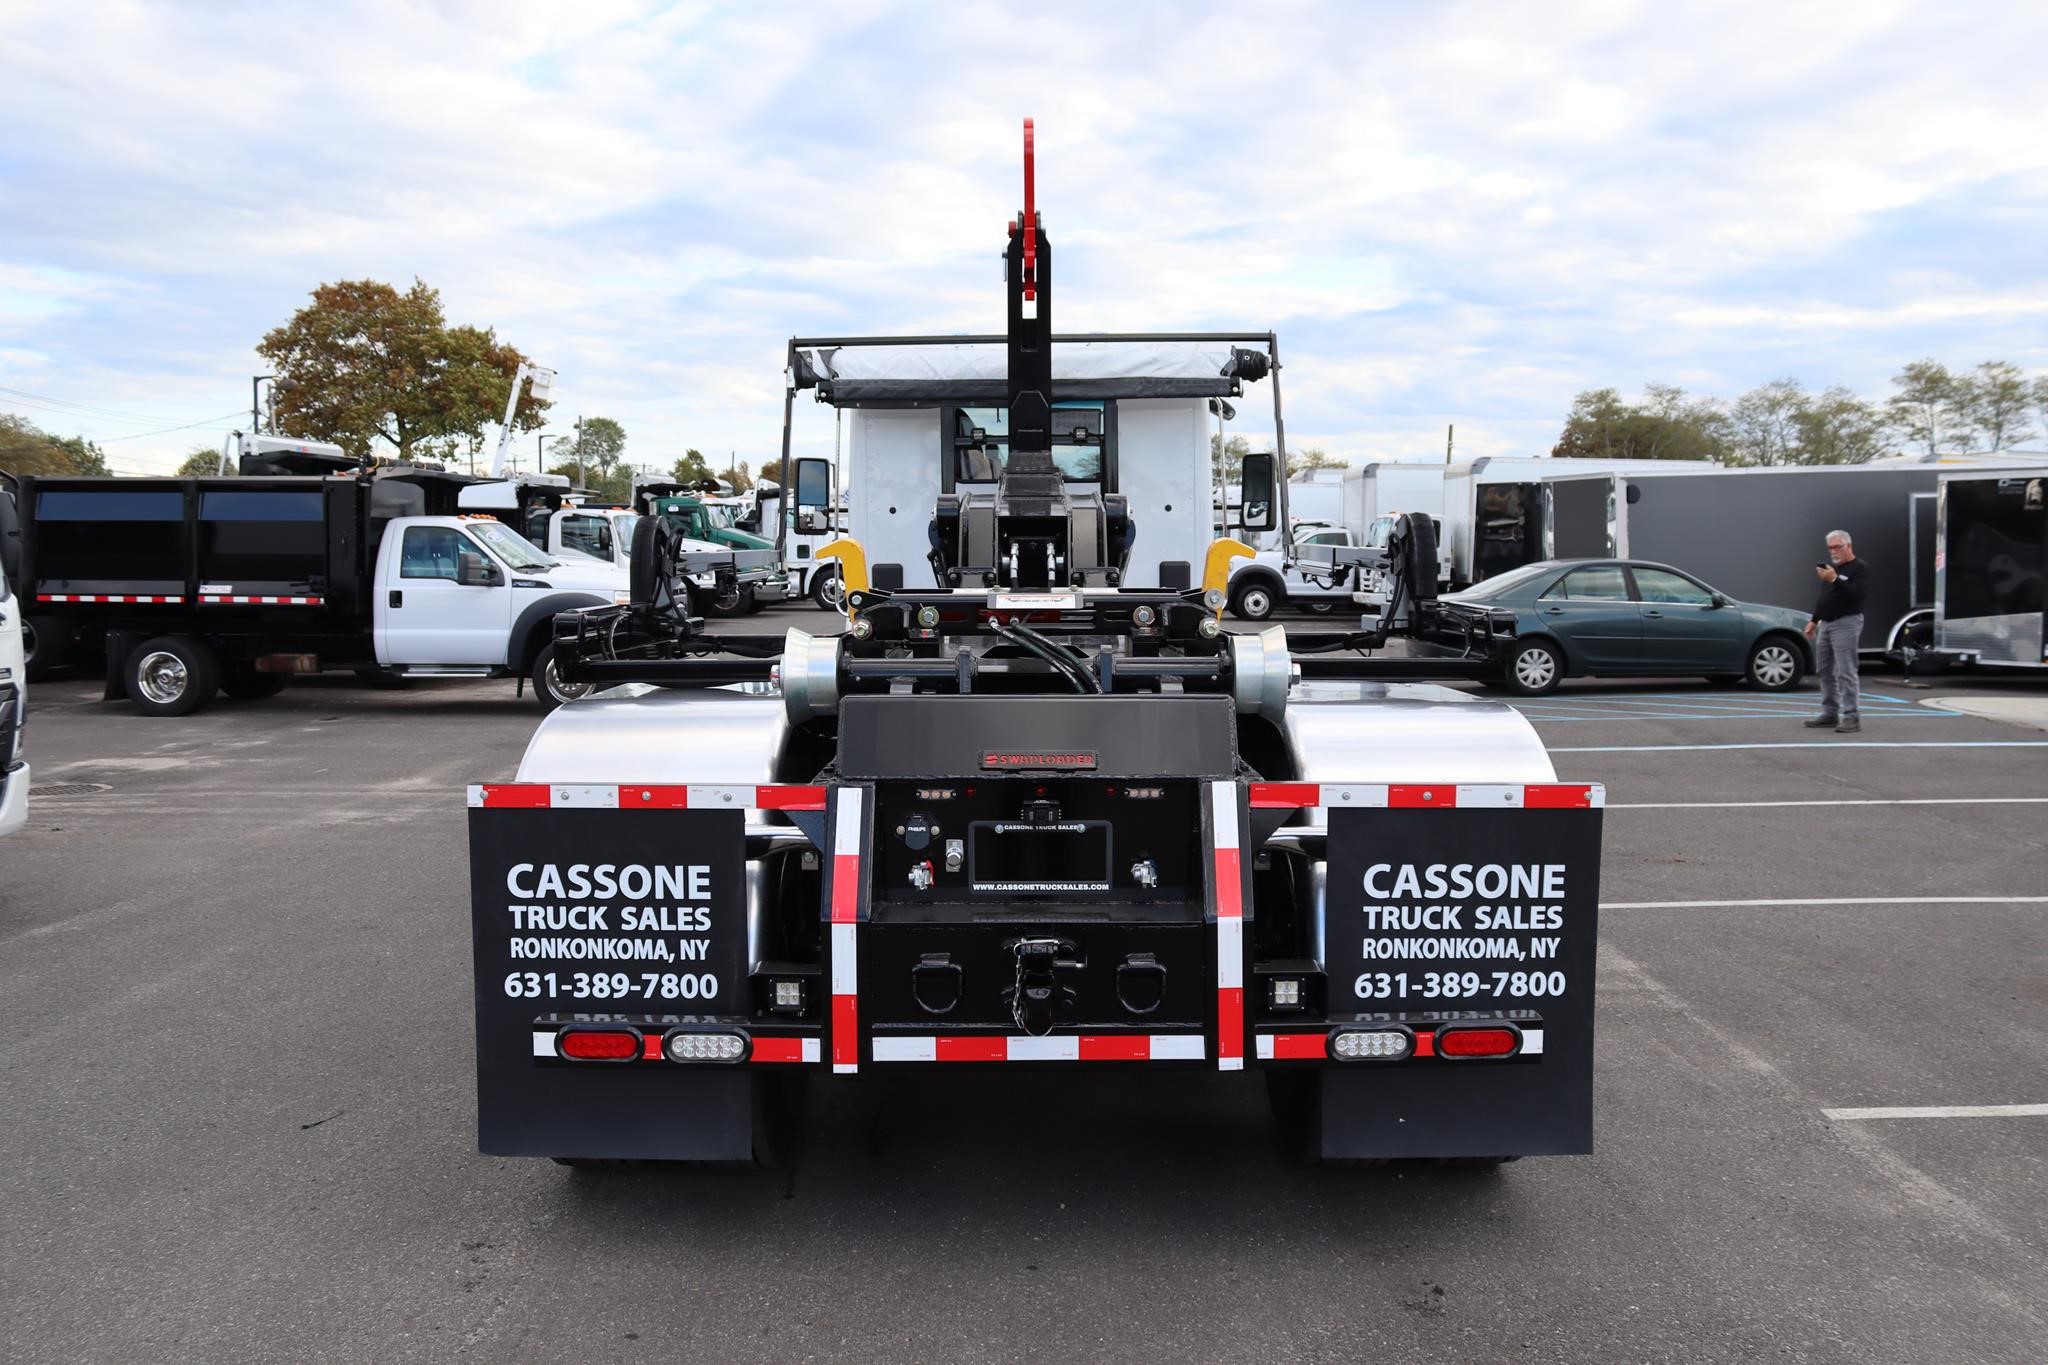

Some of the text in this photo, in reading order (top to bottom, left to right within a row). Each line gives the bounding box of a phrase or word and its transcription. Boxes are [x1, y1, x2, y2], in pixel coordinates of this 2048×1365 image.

[1000, 754, 1094, 766] SWAPLOADER
[507, 863, 712, 900] CASSONE
[972, 883, 1110, 891] WWW.CASSONETRUCKSALES.COM
[1363, 863, 1566, 899] CASSONE
[508, 905, 712, 932] TRUCK SALES
[1363, 905, 1564, 930] TRUCK SALES
[510, 937, 711, 964] RONKONKOMA, NY
[1362, 937, 1562, 962] RONKONKOMA, NY
[504, 971, 719, 1000] 631-389-7800
[1354, 970, 1567, 999] 631-389-7800
